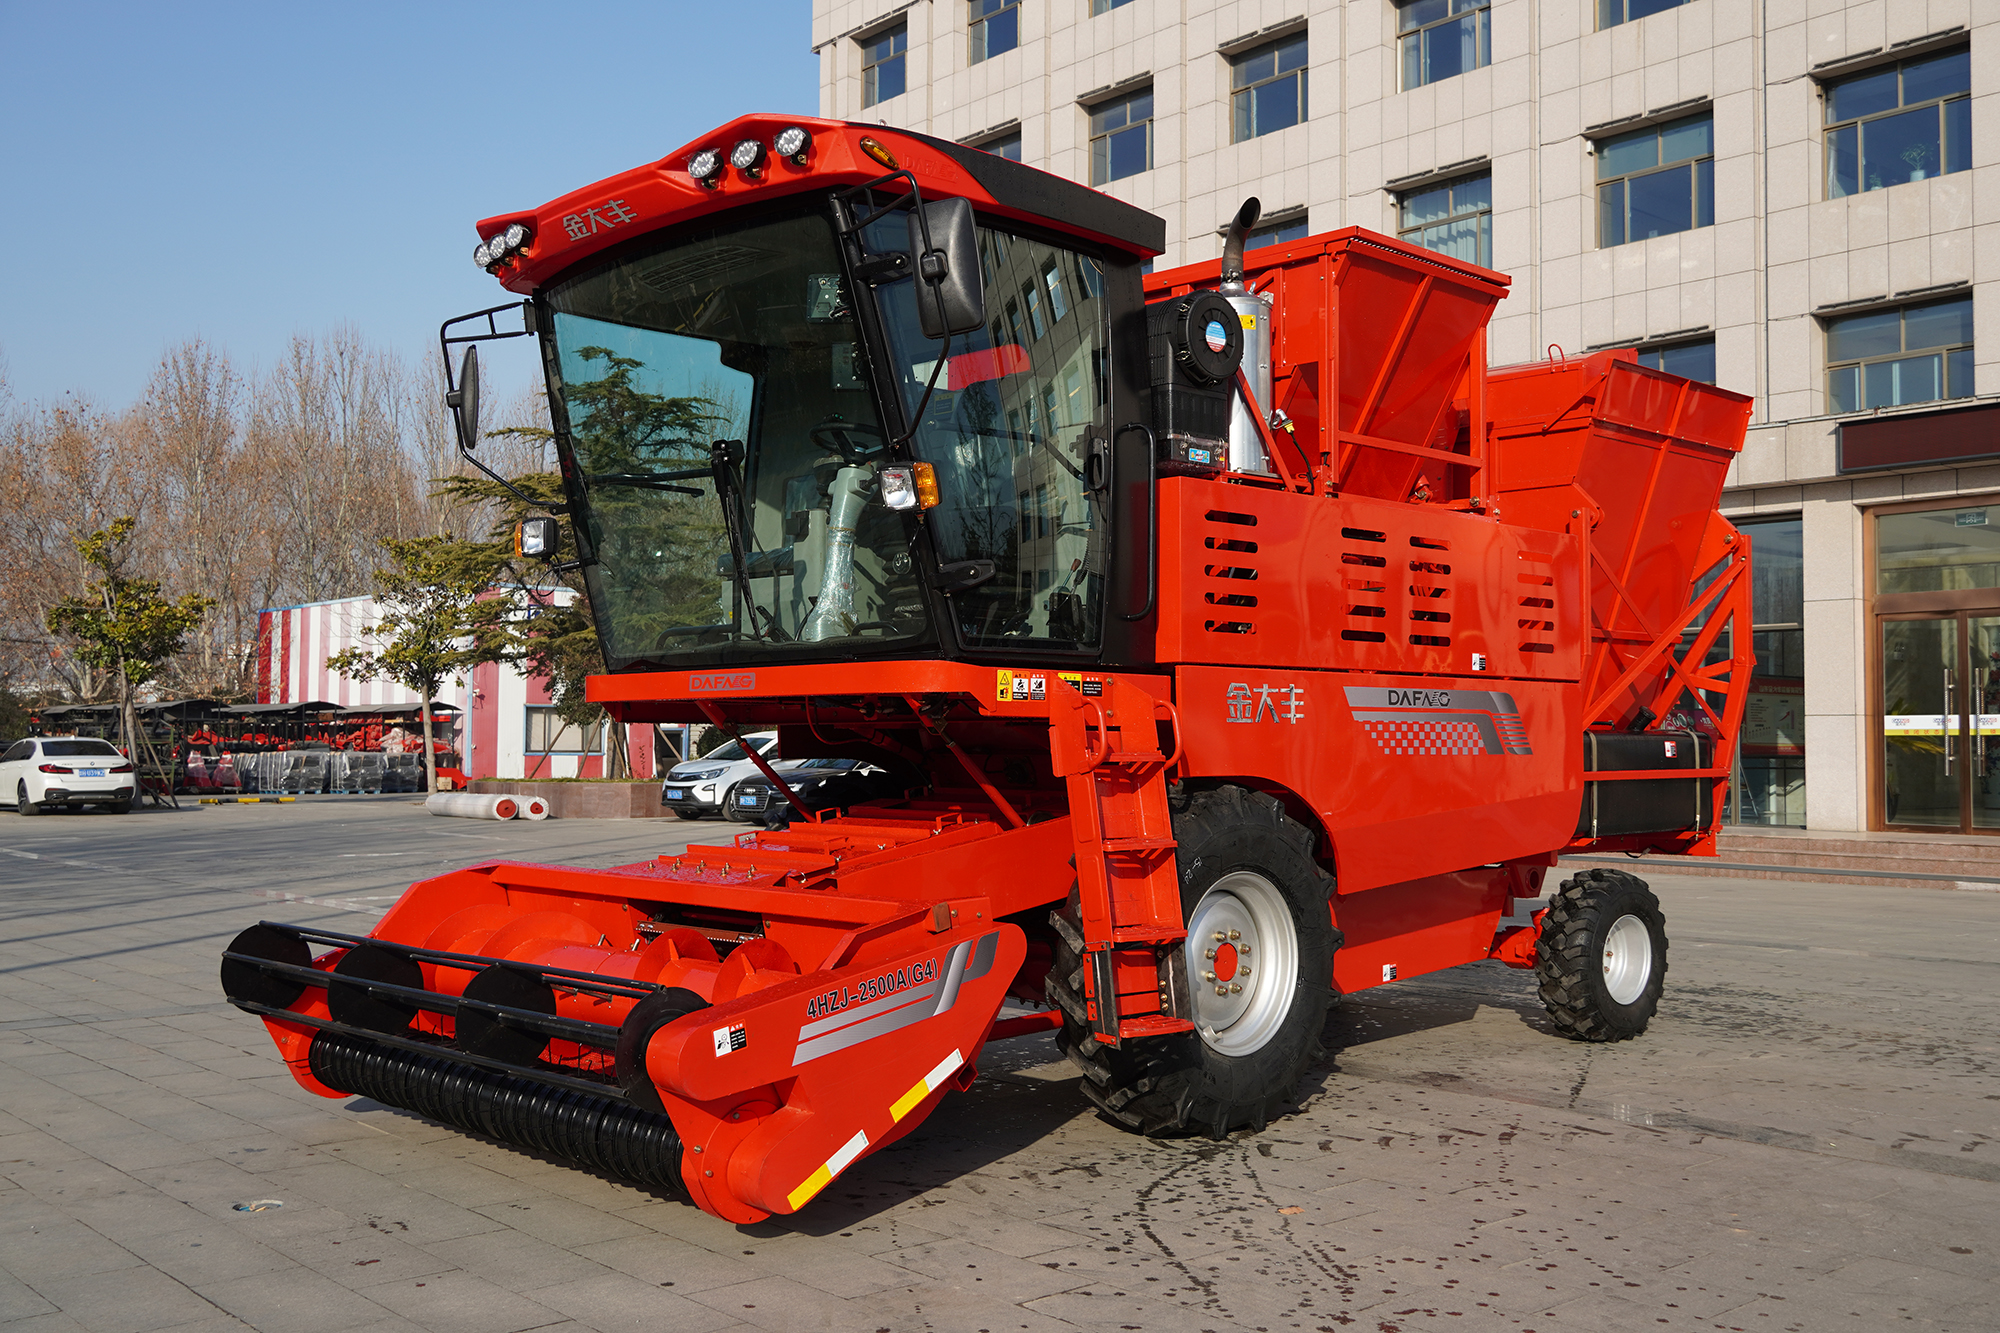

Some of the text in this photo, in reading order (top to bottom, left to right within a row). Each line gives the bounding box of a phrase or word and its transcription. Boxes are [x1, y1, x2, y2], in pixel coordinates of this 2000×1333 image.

[563, 199, 637, 241] 金大丰
[1226, 683, 1304, 724] 金大丰
[807, 958, 938, 1017] 4HZJ-2500A(G4)
